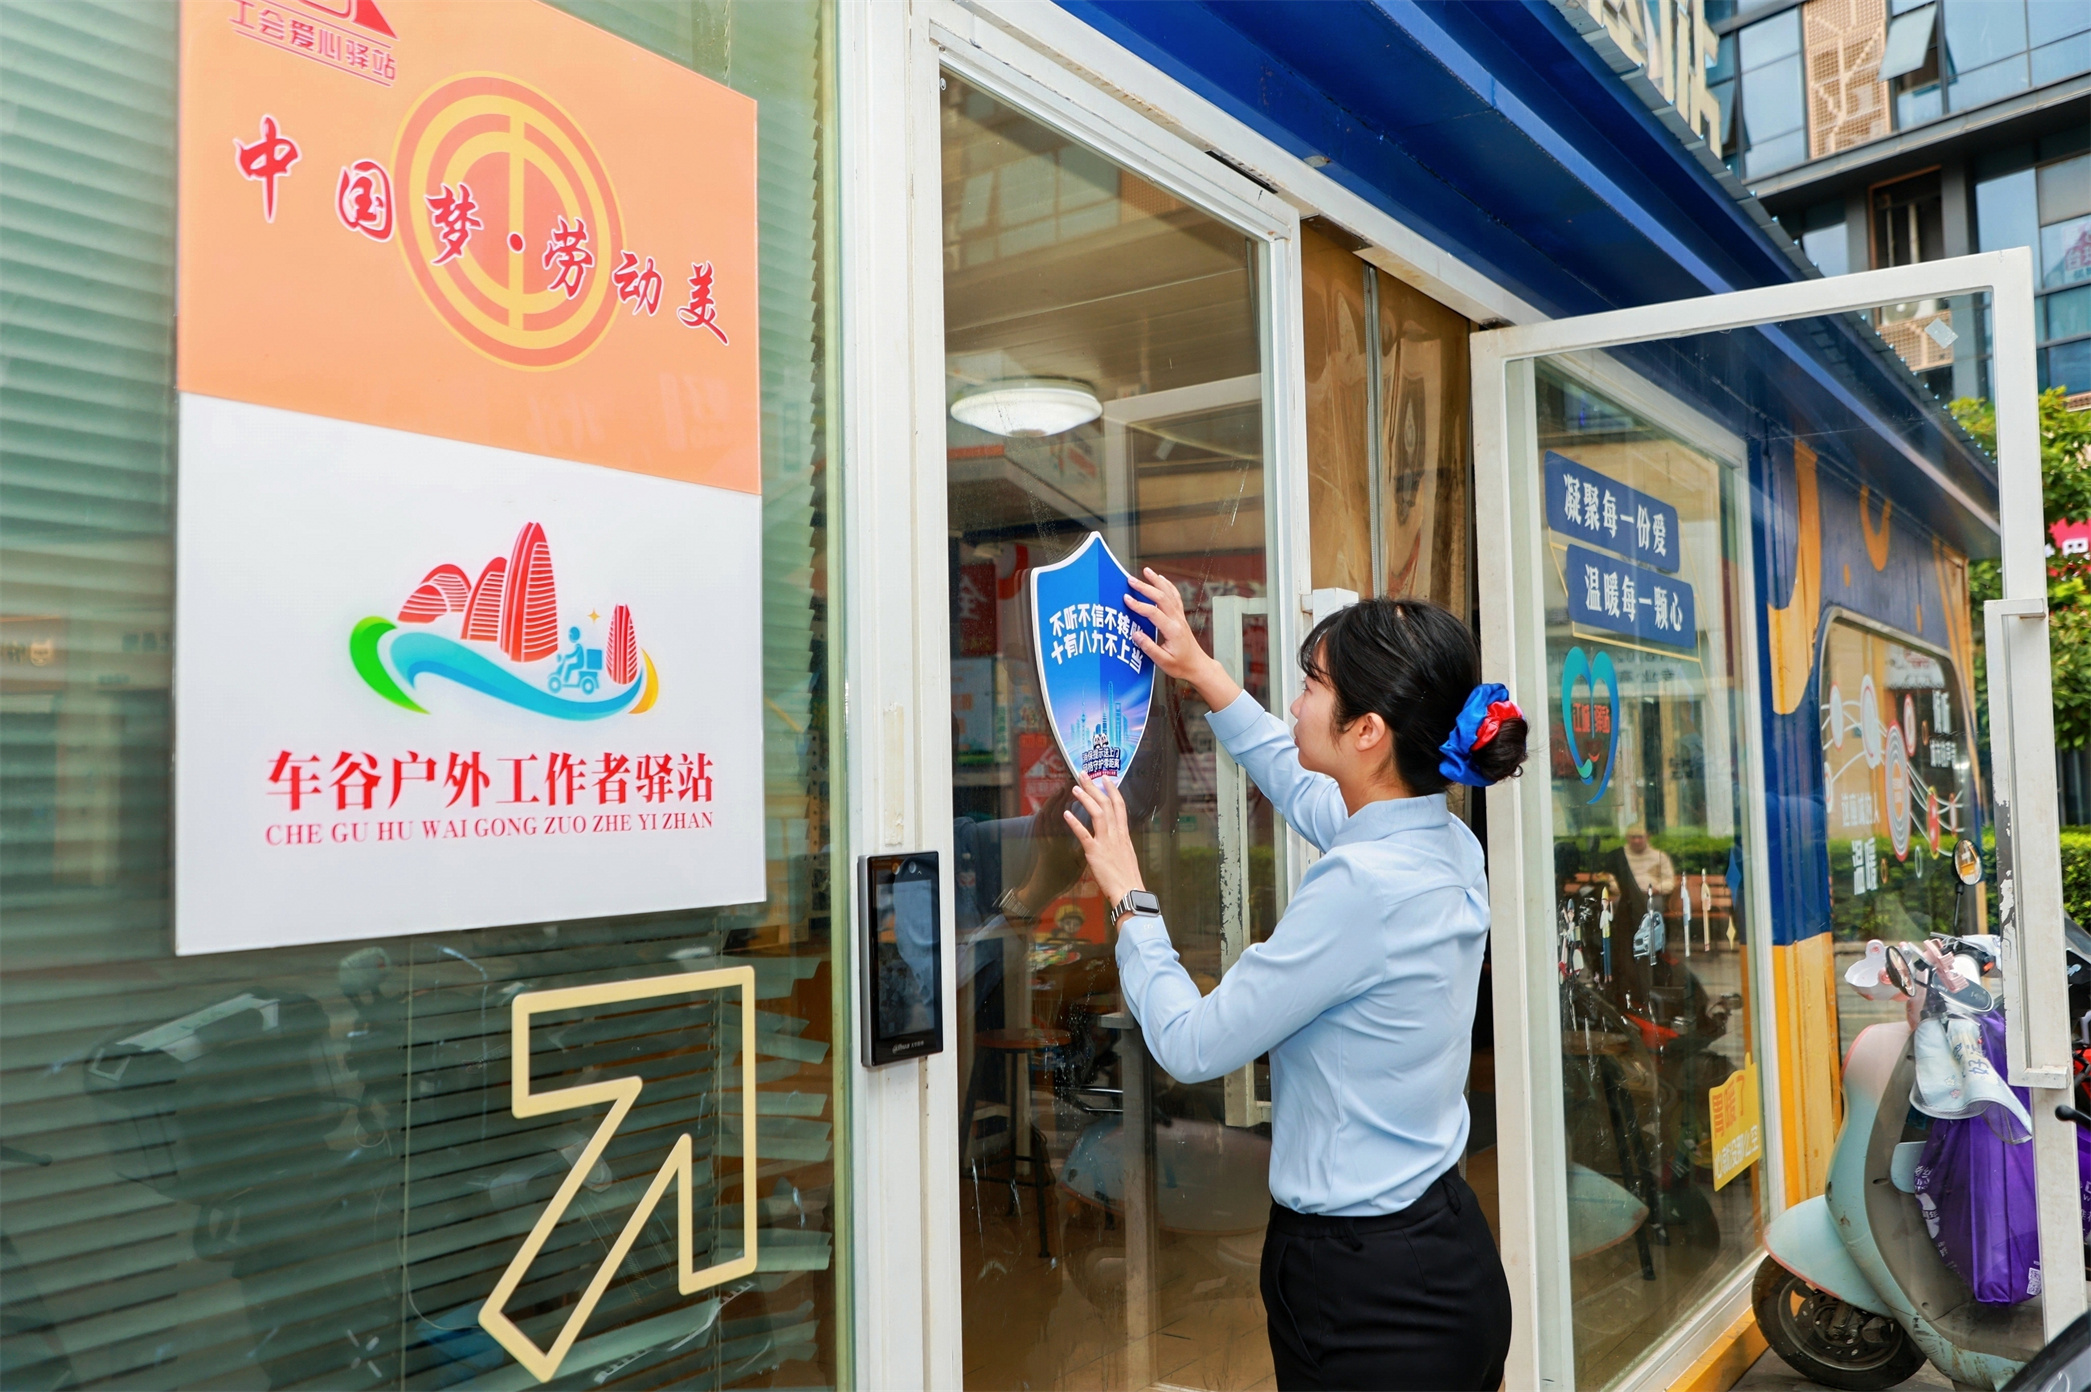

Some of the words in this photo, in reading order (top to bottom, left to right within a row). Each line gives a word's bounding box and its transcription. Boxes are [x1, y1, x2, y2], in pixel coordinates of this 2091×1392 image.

[229, 0, 396, 80] 工会爱心驿站
[1563, 473, 1667, 557] 凝聚每一份爱
[1584, 564, 1683, 632] 温暖每一颗心
[1051, 630, 1144, 674] 十有八九不上当
[266, 750, 714, 811] 车谷户外工作者驿站
[265, 824, 323, 846] CHE
[331, 822, 369, 843] GU
[377, 820, 413, 841] HU
[421, 819, 468, 839] WAI
[474, 817, 537, 837] GONG
[544, 815, 587, 835] ZUO
[592, 814, 632, 832] ZHE
[638, 813, 657, 831] YI
[662, 811, 713, 830] ZHAN
